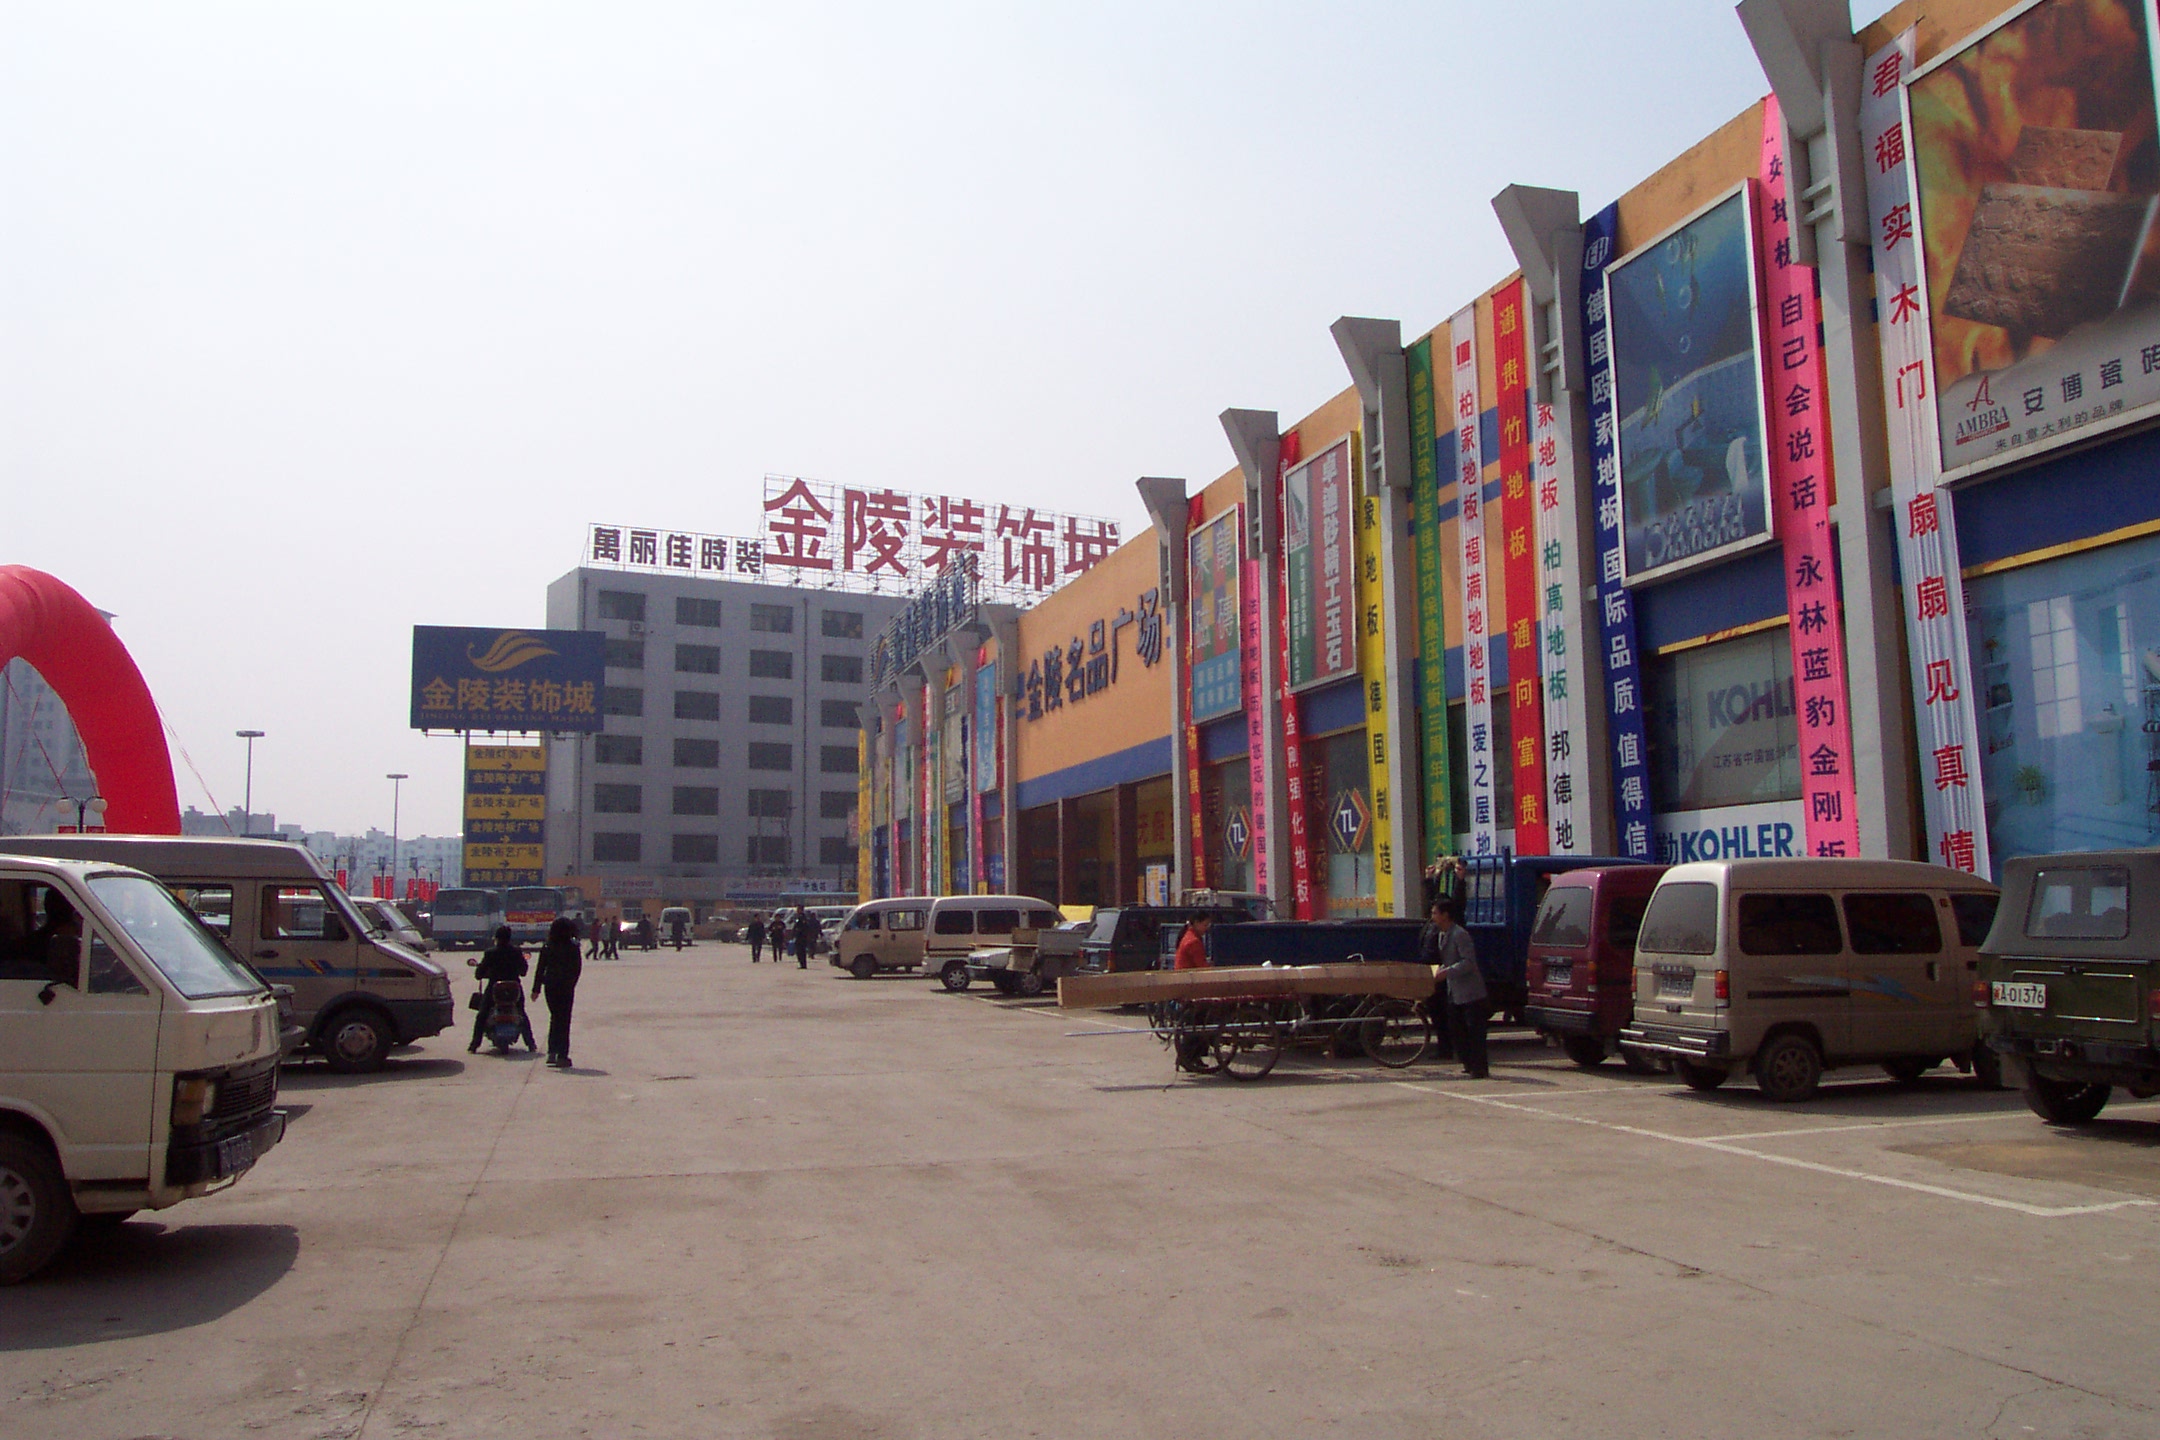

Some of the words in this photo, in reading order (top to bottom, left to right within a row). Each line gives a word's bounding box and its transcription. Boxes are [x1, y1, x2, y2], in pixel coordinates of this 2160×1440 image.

[1497, 303, 1529, 561] 通贵竹地板
[1872, 48, 1925, 411] 君福实木门
[1908, 491, 1975, 874] 扇扇见真情
[1955, 405, 2010, 440] AMBRA
[764, 477, 1119, 592] 金陵装饰城
[1026, 586, 1162, 723] 金陵名品广场
[1603, 549, 1637, 715] 国际品质
[420, 675, 597, 715] 金陵装饰城
[1511, 615, 1540, 827] 通向富贵
[1231, 821, 1246, 844] TL
[1339, 808, 1358, 834] TL
[1680, 821, 1795, 861] KOHLER
